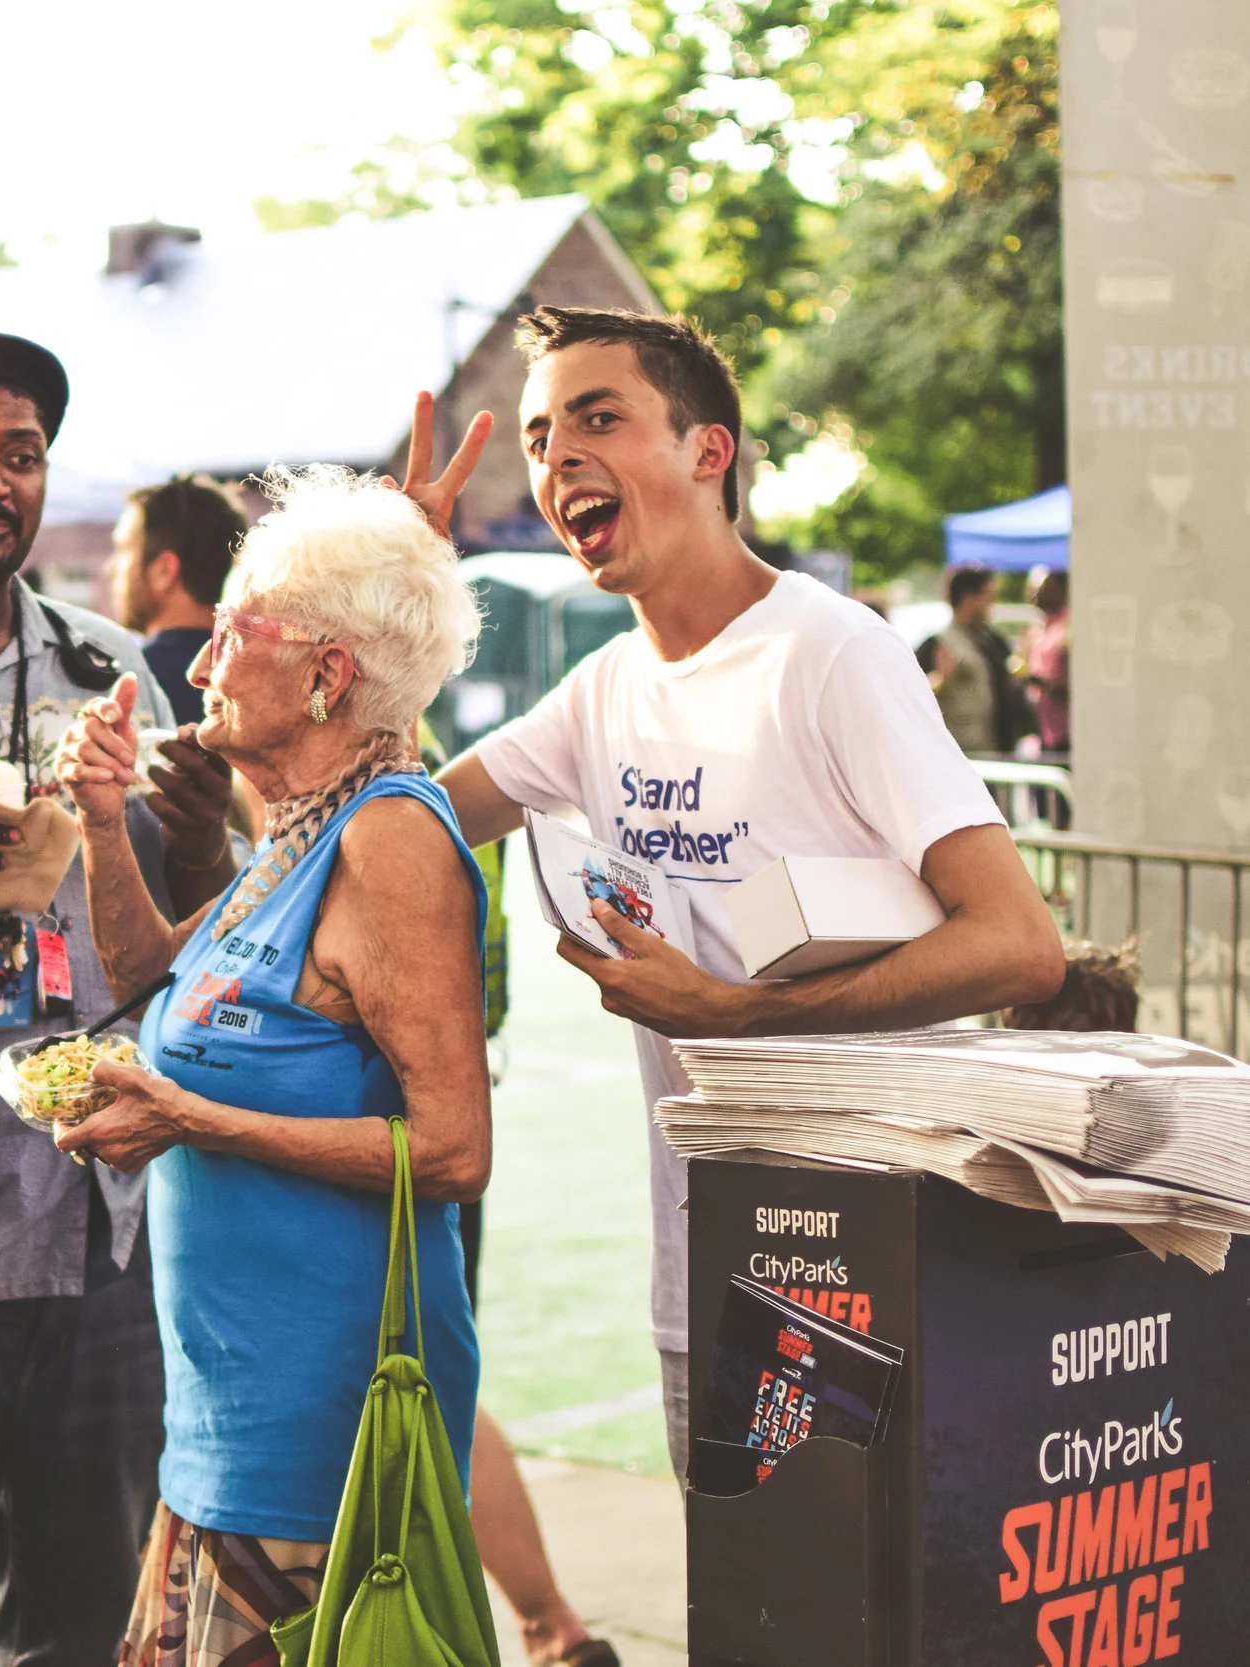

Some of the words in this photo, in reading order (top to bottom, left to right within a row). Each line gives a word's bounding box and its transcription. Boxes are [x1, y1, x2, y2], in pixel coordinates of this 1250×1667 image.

[259, 944, 280, 967] TO
[217, 1009, 249, 1029] 2018
[756, 1207, 840, 1239] SUPPORT
[1052, 1313, 1171, 1386] SUPPORT
[755, 1396, 810, 1439] EVENTS
[758, 1370, 817, 1422] FREE
[750, 1415, 797, 1449] ACROS
[999, 1461, 1213, 1604] SUMMER
[1036, 1566, 1185, 1667] STAGE
